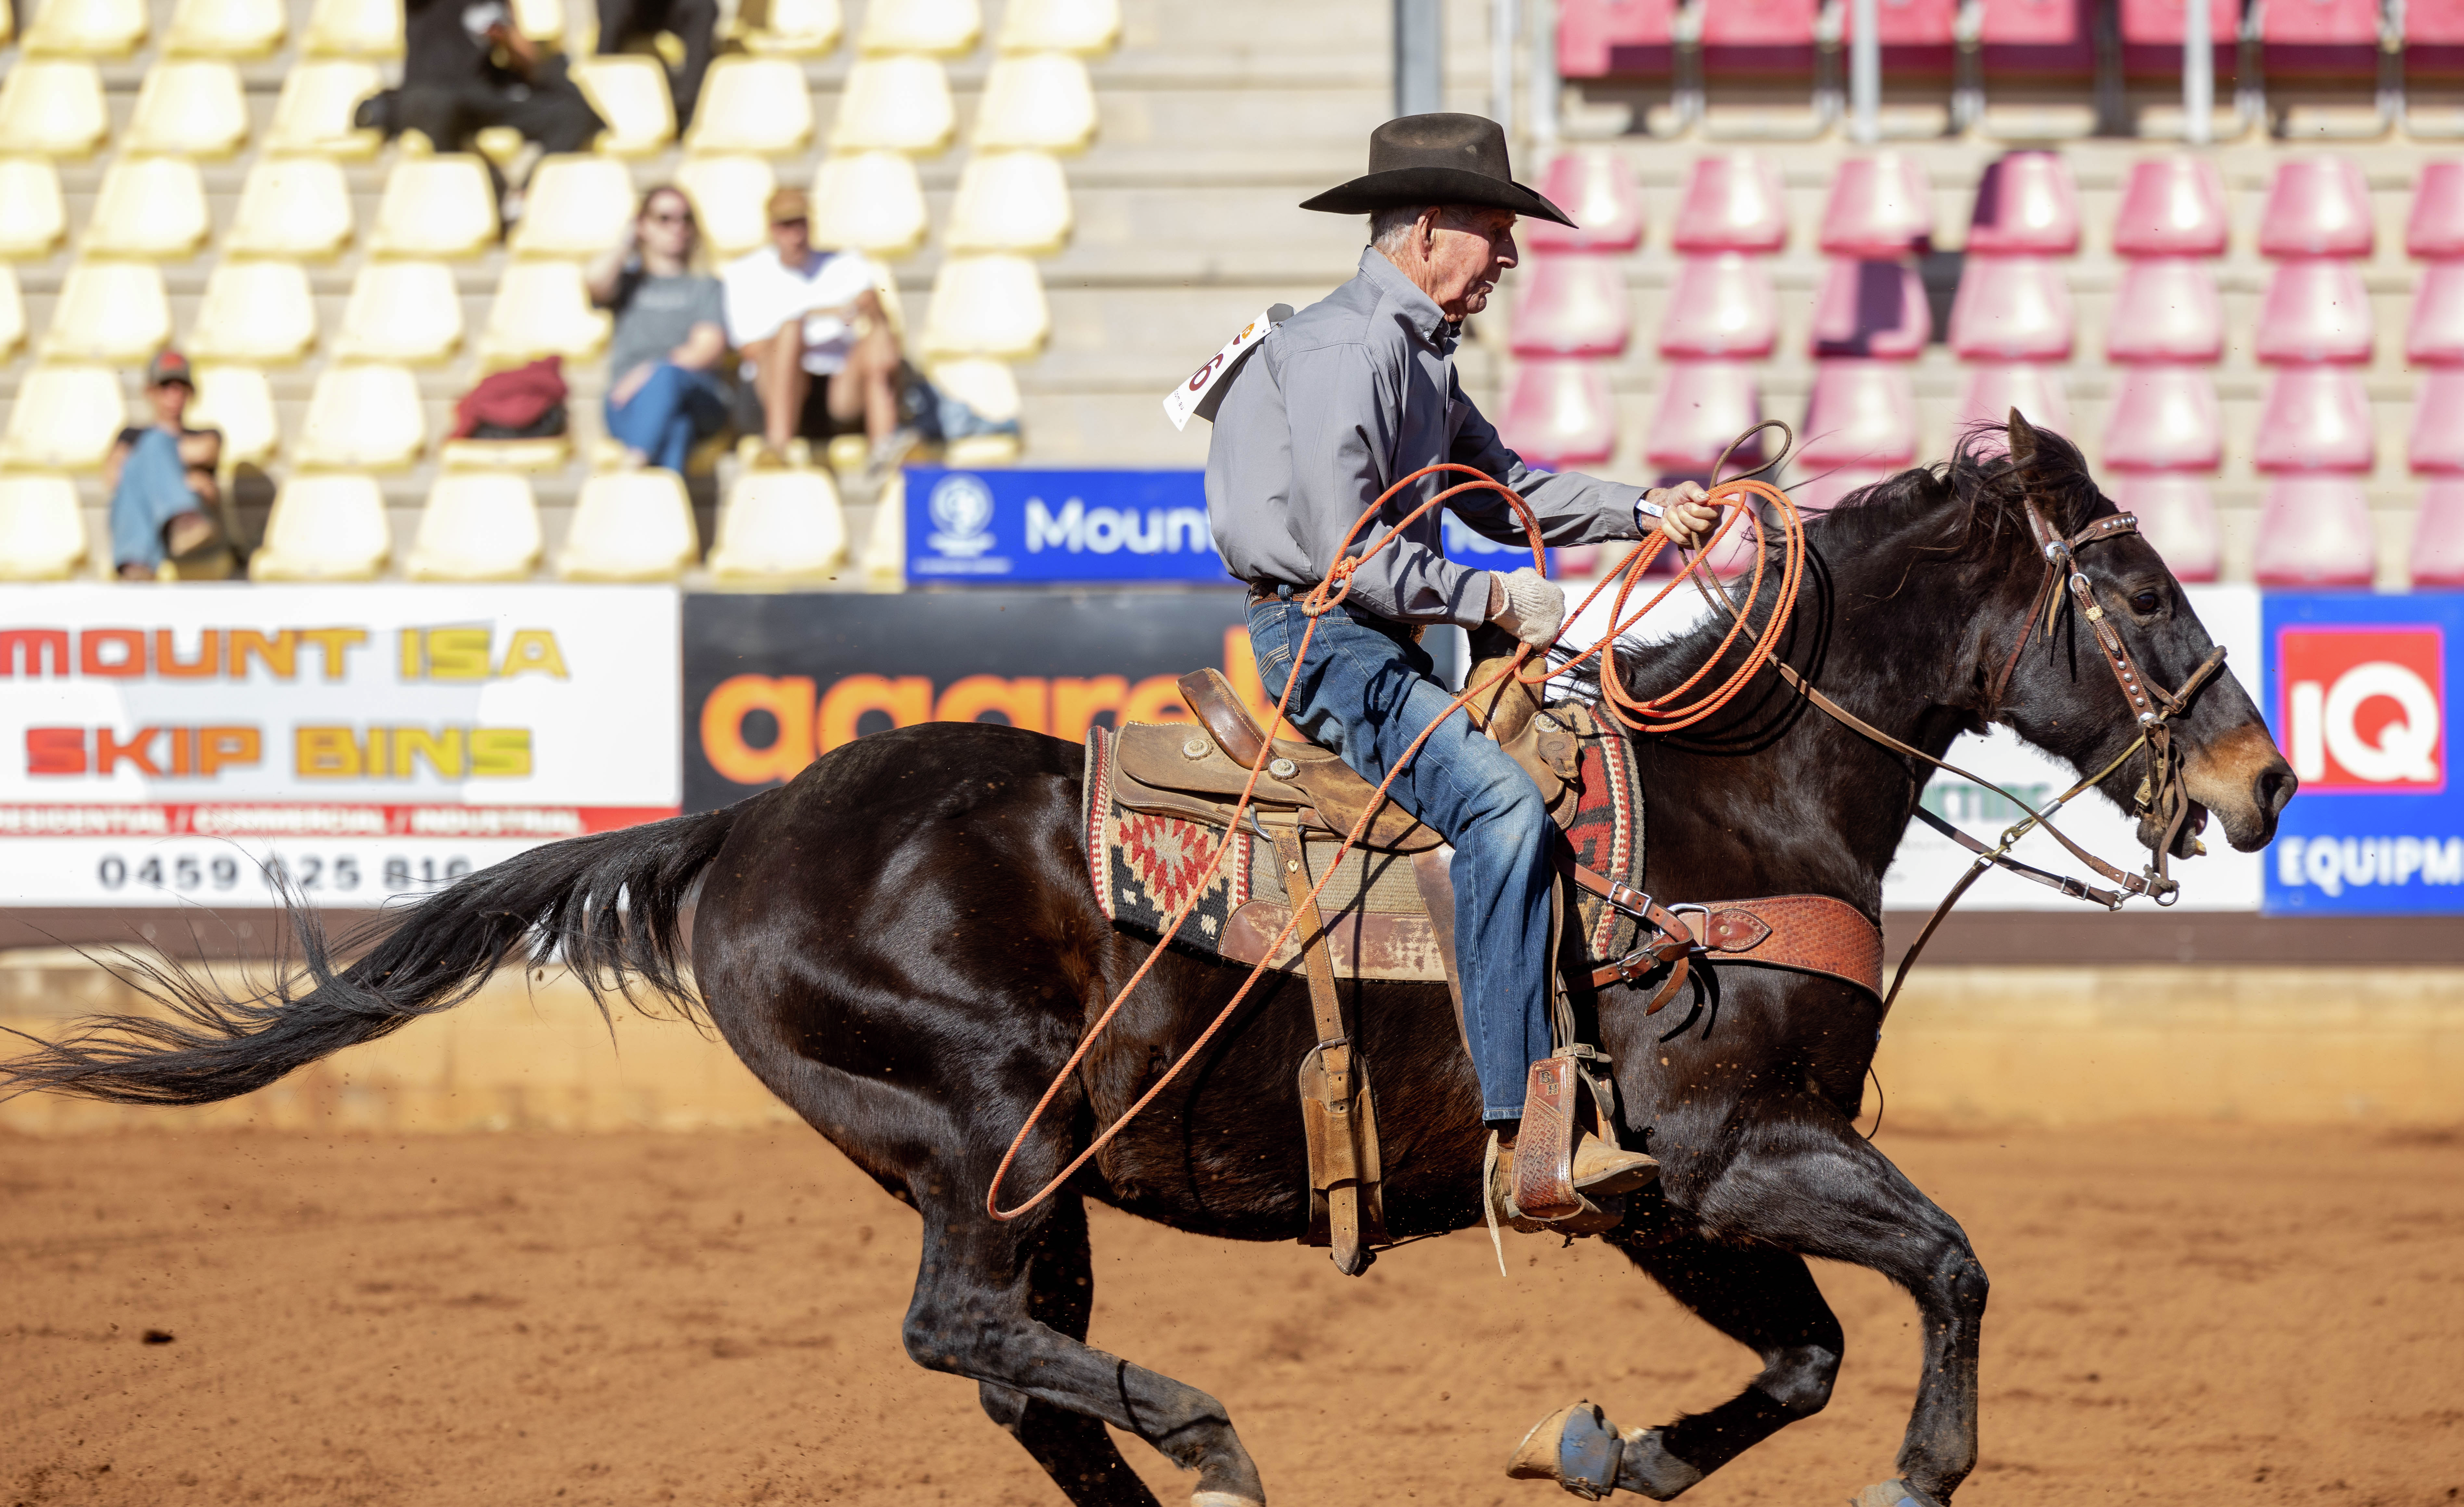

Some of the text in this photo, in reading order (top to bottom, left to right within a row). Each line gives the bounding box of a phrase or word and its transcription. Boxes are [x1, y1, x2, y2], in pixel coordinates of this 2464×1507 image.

[1189, 347, 1224, 391] 6
[1025, 496, 1225, 554] Moun
[0, 628, 570, 680] MOUNT ISA
[2291, 661, 2440, 783] IQ
[25, 726, 532, 777] SKIP BINS
[99, 853, 239, 890] 0459
[2279, 835, 2464, 897] EQUIPM
